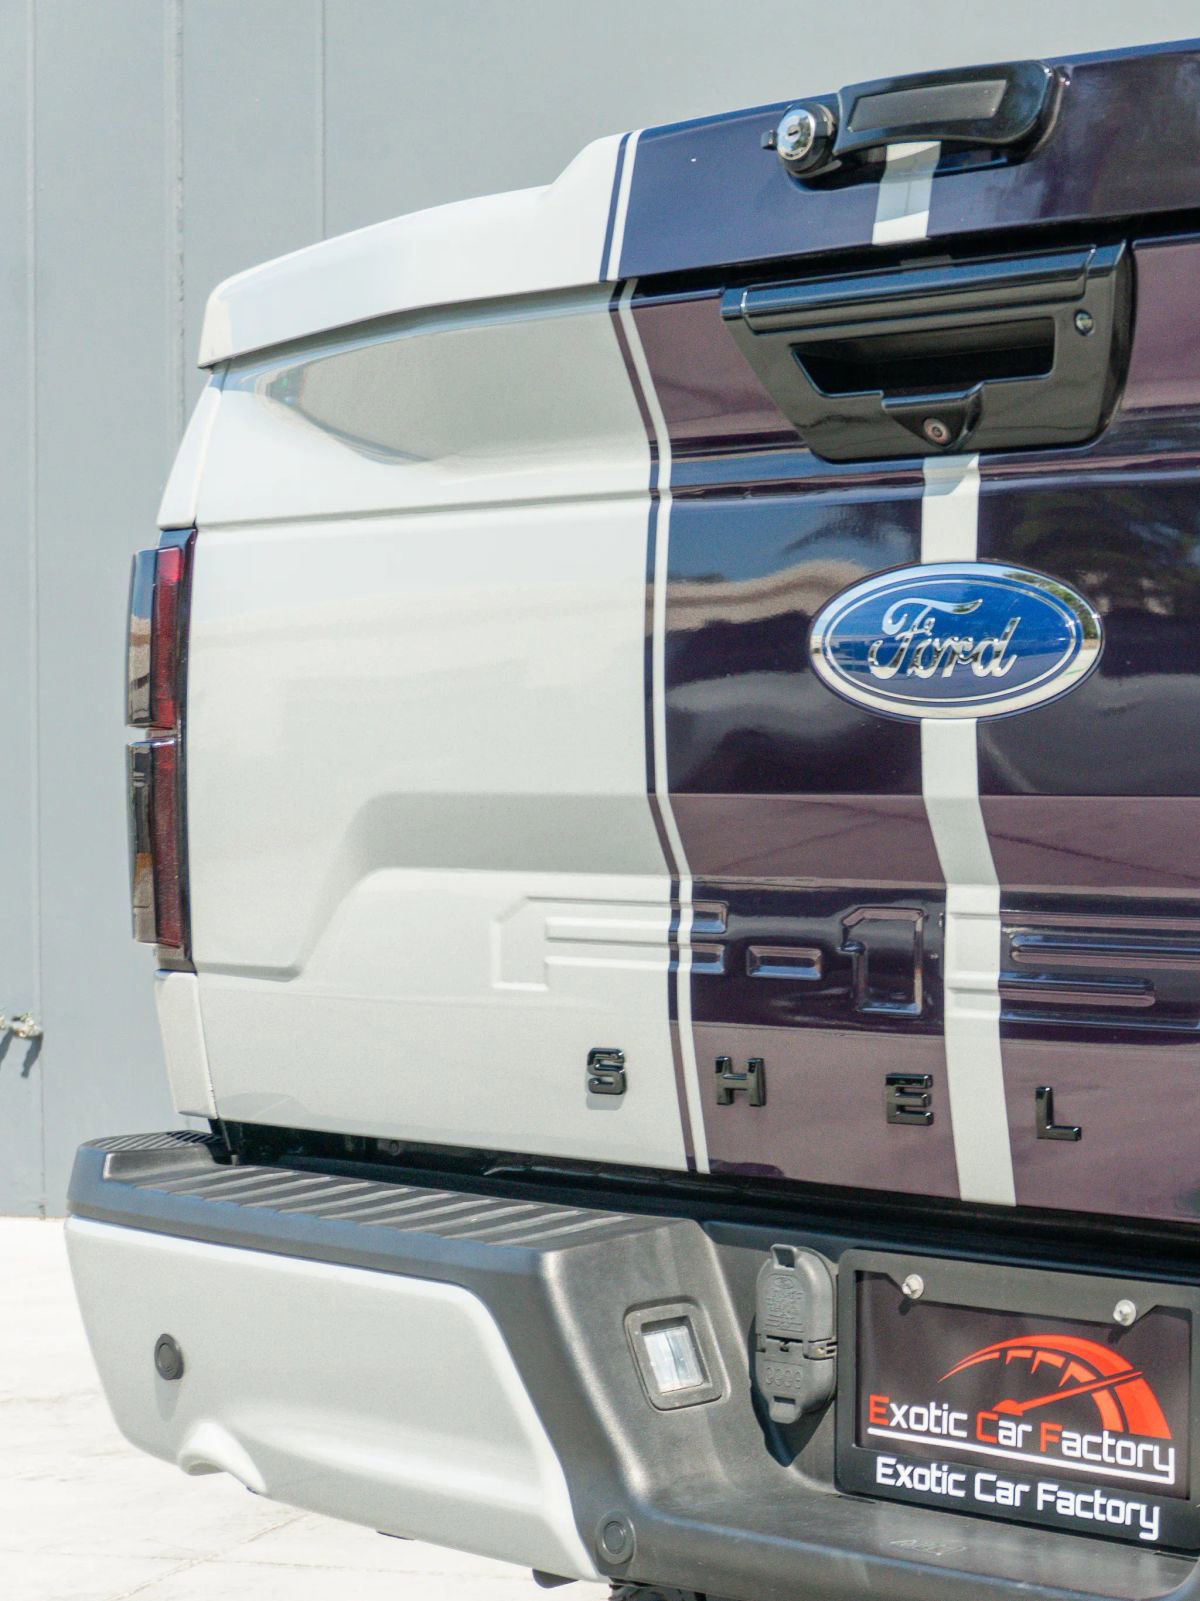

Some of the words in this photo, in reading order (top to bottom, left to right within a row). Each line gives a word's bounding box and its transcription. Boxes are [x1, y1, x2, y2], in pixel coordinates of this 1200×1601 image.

[868, 598, 1021, 680] Ford
[868, 1393, 968, 1438] Exotic
[975, 1411, 1033, 1449] Car
[1039, 1422, 1176, 1485] Factory
[875, 1455, 967, 1498] Exotic
[973, 1472, 1031, 1508] Car
[1036, 1481, 1161, 1542] Factory
